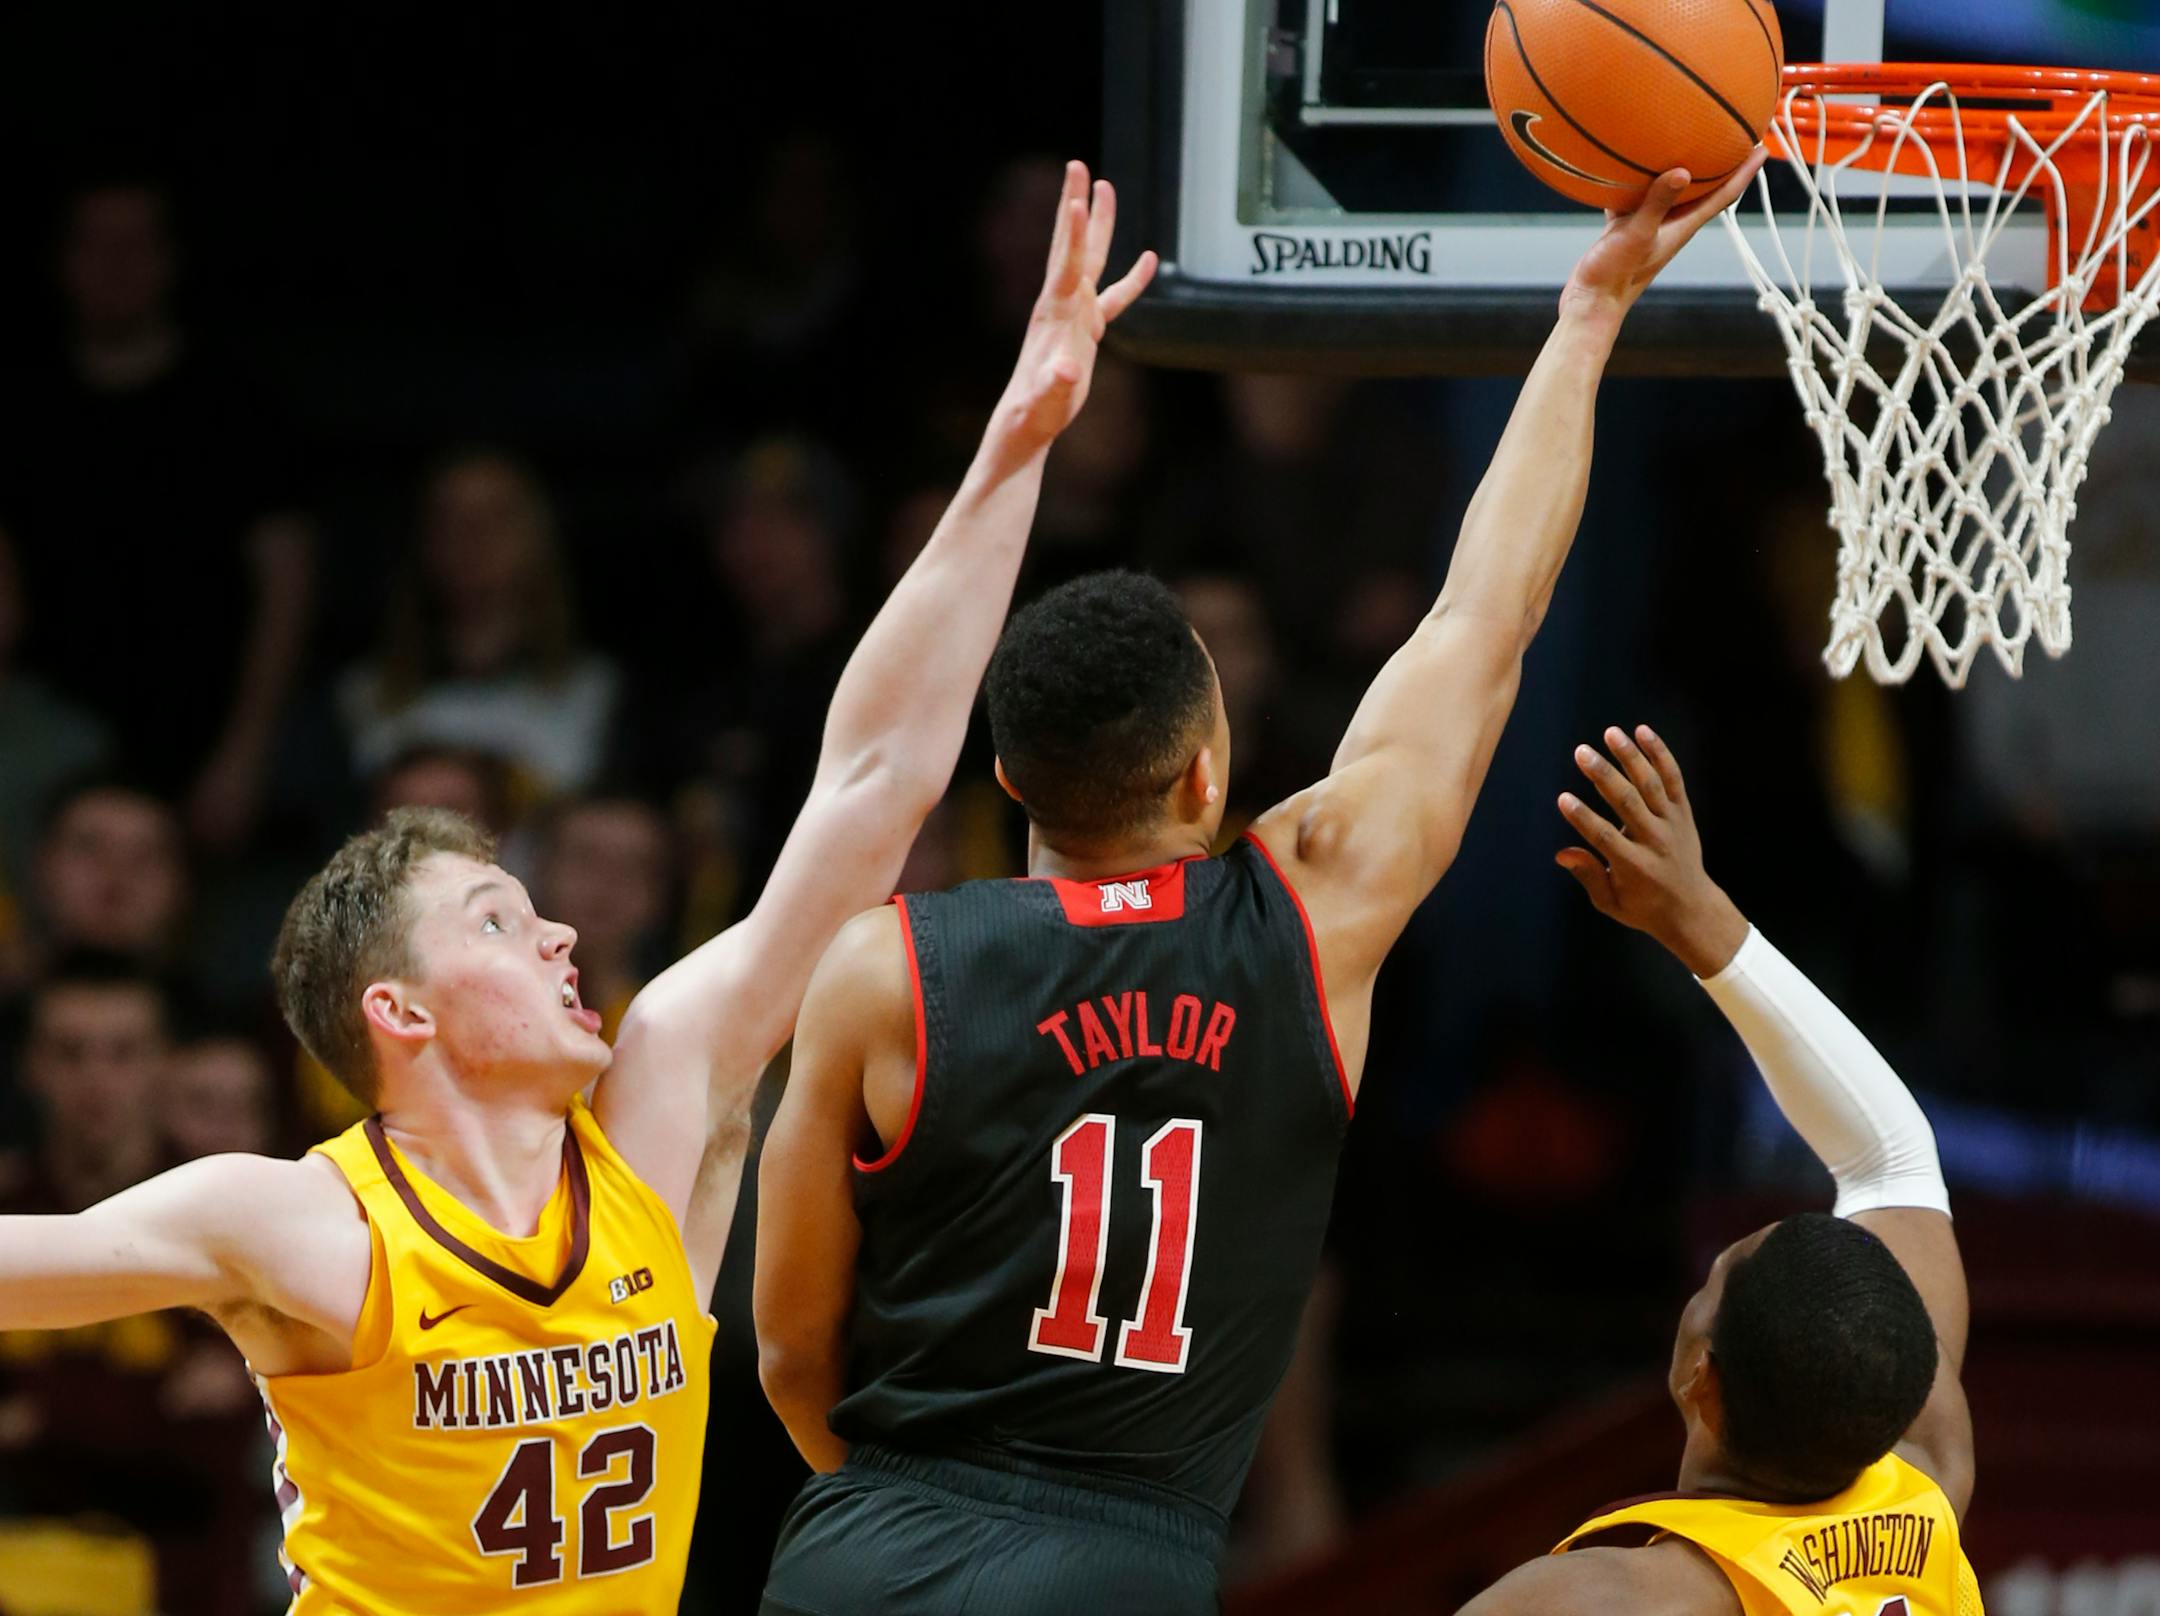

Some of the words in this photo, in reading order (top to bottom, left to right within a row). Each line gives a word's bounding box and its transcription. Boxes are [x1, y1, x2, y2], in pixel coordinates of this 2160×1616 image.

[1252, 232, 1432, 275] SPALDING
[1098, 879, 1152, 912] N
[1036, 991, 1236, 1076] TAYLOR
[1027, 1113, 1203, 1373] 11
[413, 1319, 686, 1431] MINNESOTA
[470, 1422, 657, 1590] 42
[1779, 1513, 1935, 1606] WSHINGTON
